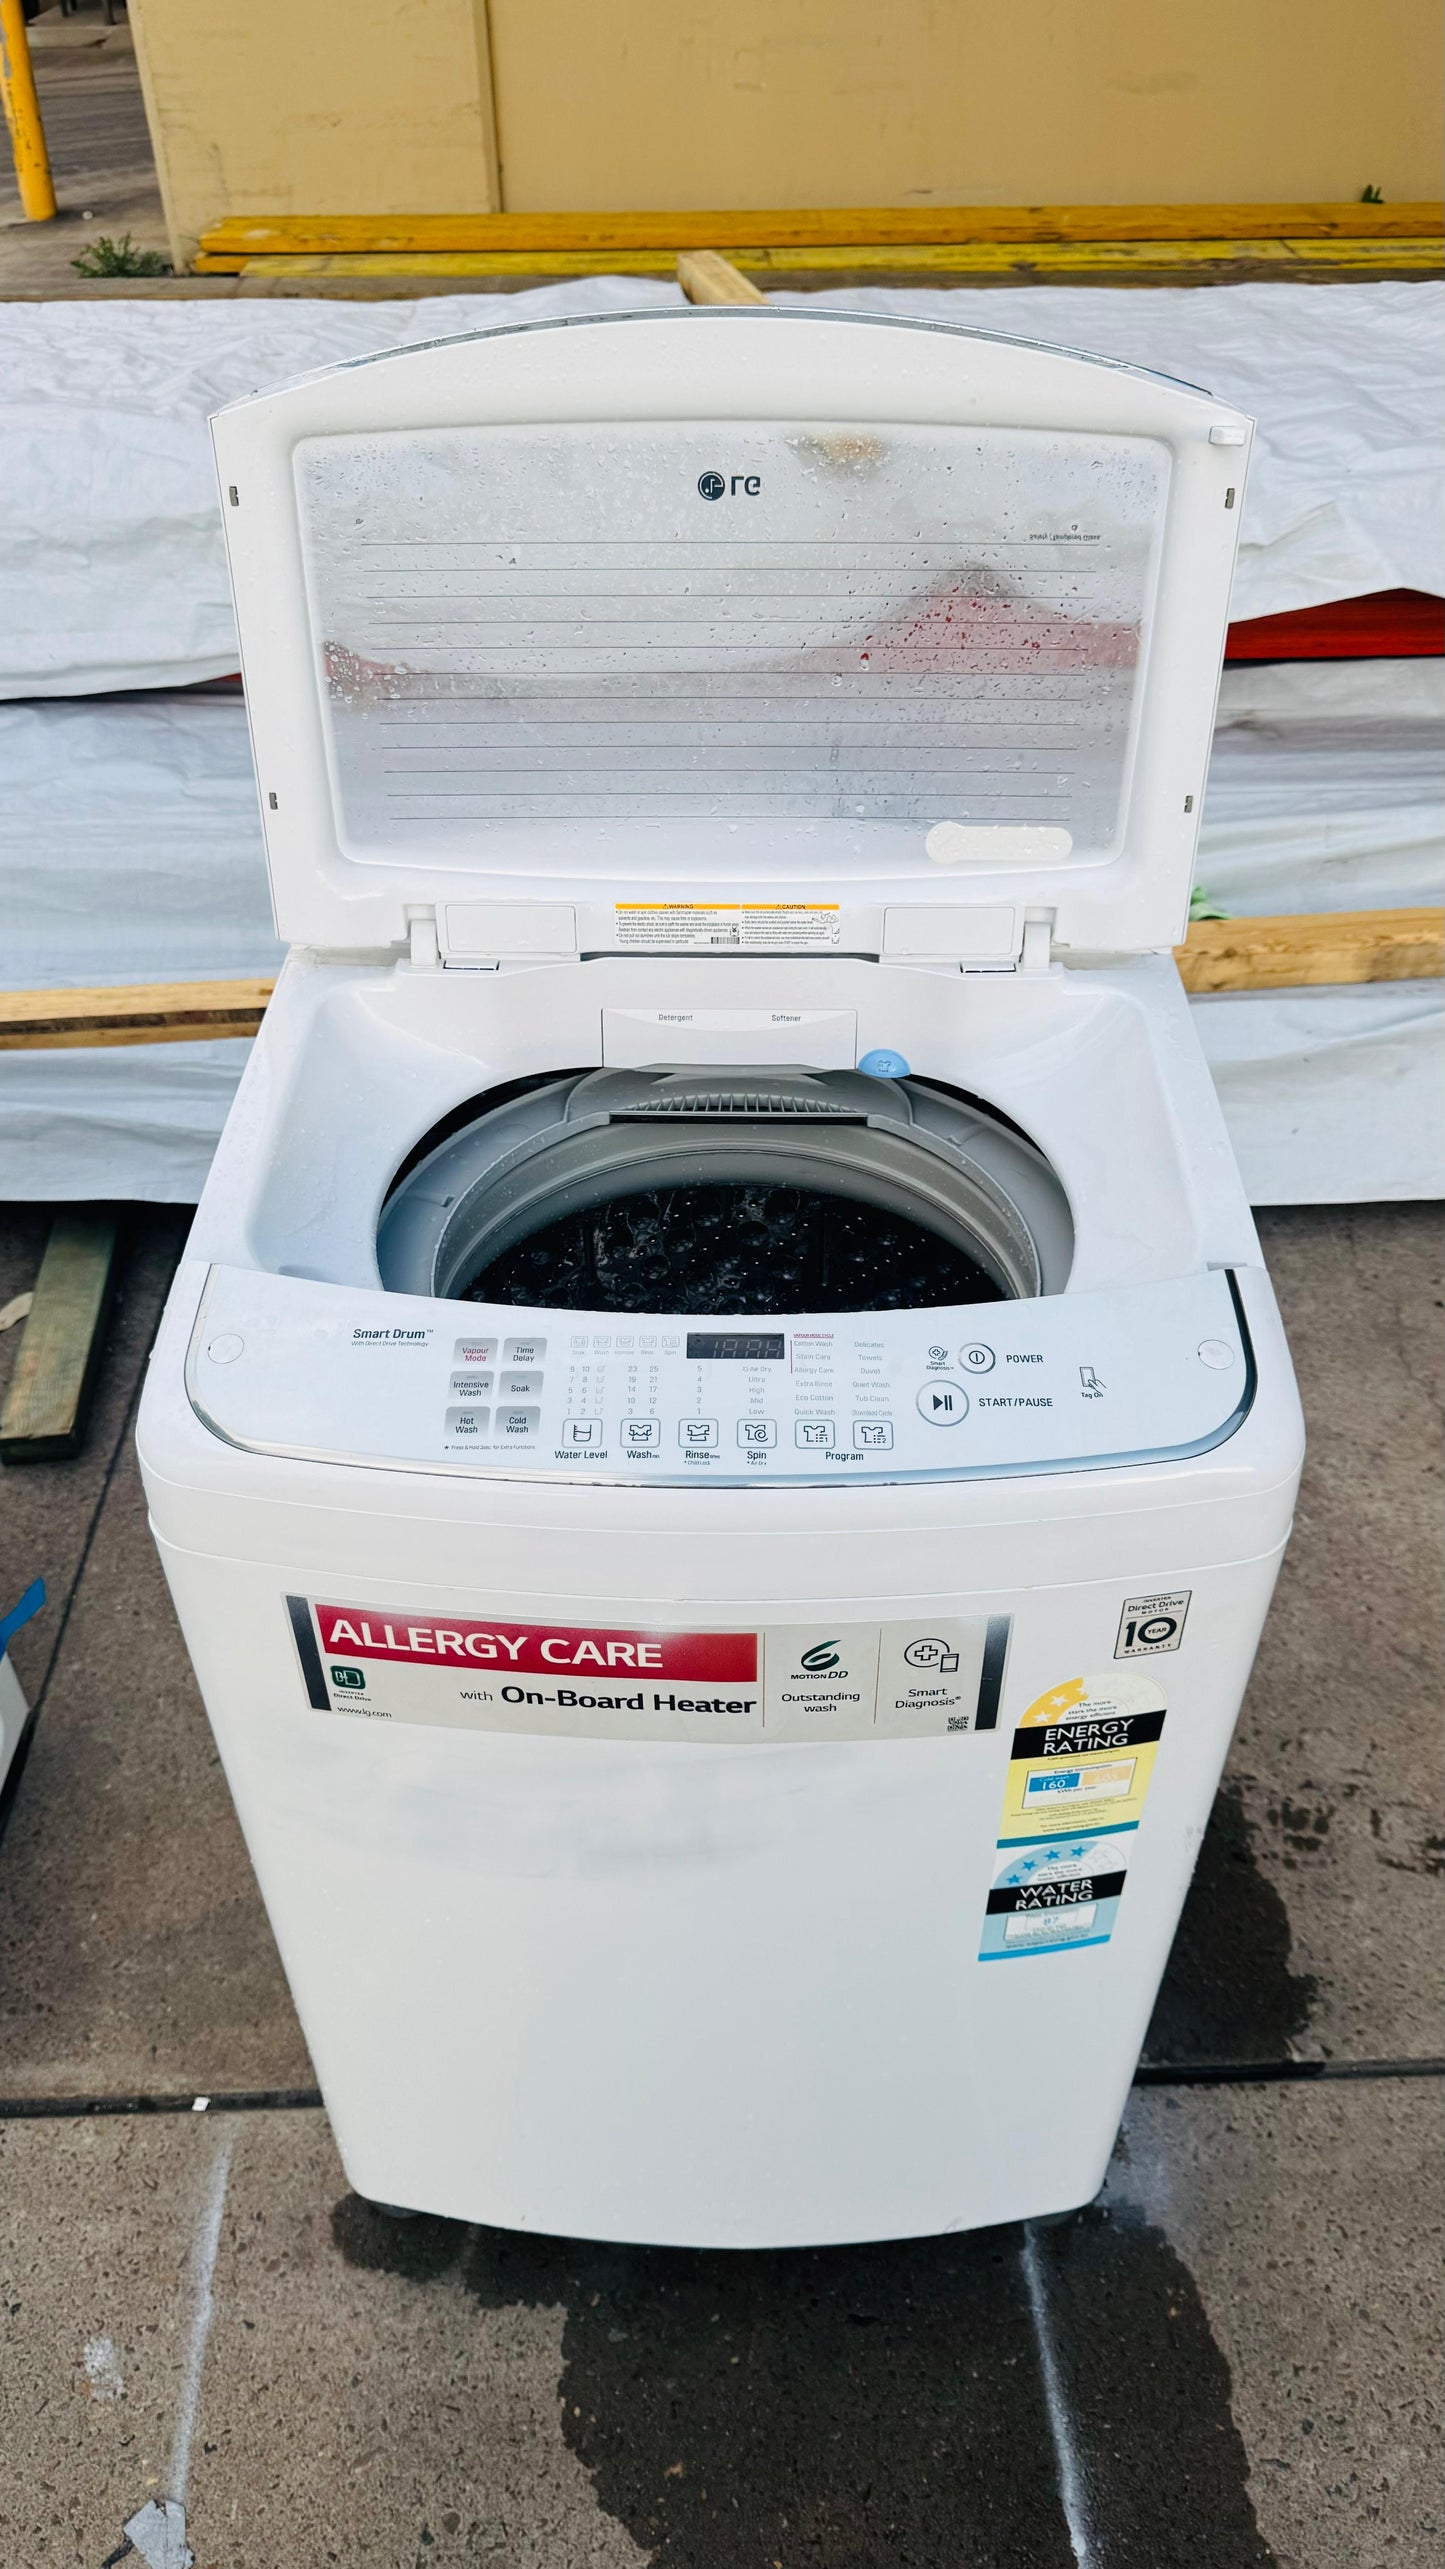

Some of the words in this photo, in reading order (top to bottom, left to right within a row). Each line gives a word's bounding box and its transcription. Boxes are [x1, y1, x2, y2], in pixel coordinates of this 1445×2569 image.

[658, 1014, 693, 1023] Detergent
[771, 1014, 801, 1022] Softener
[353, 1328, 390, 1339] Smart
[462, 1347, 489, 1355] Vapour
[513, 1355, 535, 1363] Delay
[1006, 1354, 1044, 1363] POWER
[453, 1381, 489, 1389] Intensive
[459, 1389, 482, 1397] Wash
[978, 1398, 1053, 1407] START/PAUSE
[794, 1408, 814, 1416] Quick
[815, 1408, 836, 1416] Wash
[460, 1417, 474, 1425] Hot
[509, 1417, 527, 1425] Cold
[455, 1426, 479, 1434] Wash
[554, 1451, 582, 1459] Water
[584, 1451, 608, 1459] Level
[627, 1451, 652, 1459] Wash
[685, 1451, 709, 1459] Rinse
[747, 1451, 767, 1460] Spin
[825, 1451, 864, 1462] Program
[1127, 1602, 1156, 1612] Direct
[1158, 1599, 1184, 1608] Drive
[1125, 1617, 1177, 1648] 10
[329, 1618, 528, 1660] ALLERGY
[540, 1638, 664, 1668] CARE
[1124, 1643, 1171, 1654] WARRANTY
[827, 1670, 848, 1679] DD
[908, 1687, 948, 1697] Smart
[459, 1690, 493, 1702] with
[501, 1686, 644, 1710] On-Board
[653, 1694, 758, 1714] Heater
[781, 1692, 861, 1702] Outstanding
[804, 1703, 837, 1713] wash
[1045, 1718, 1134, 1741] ENERGY
[1043, 1733, 1129, 1755] RATING
[1042, 1780, 1066, 1790] 160
[1020, 1879, 1094, 1899] WATER
[1015, 1889, 1094, 1911] RATING
